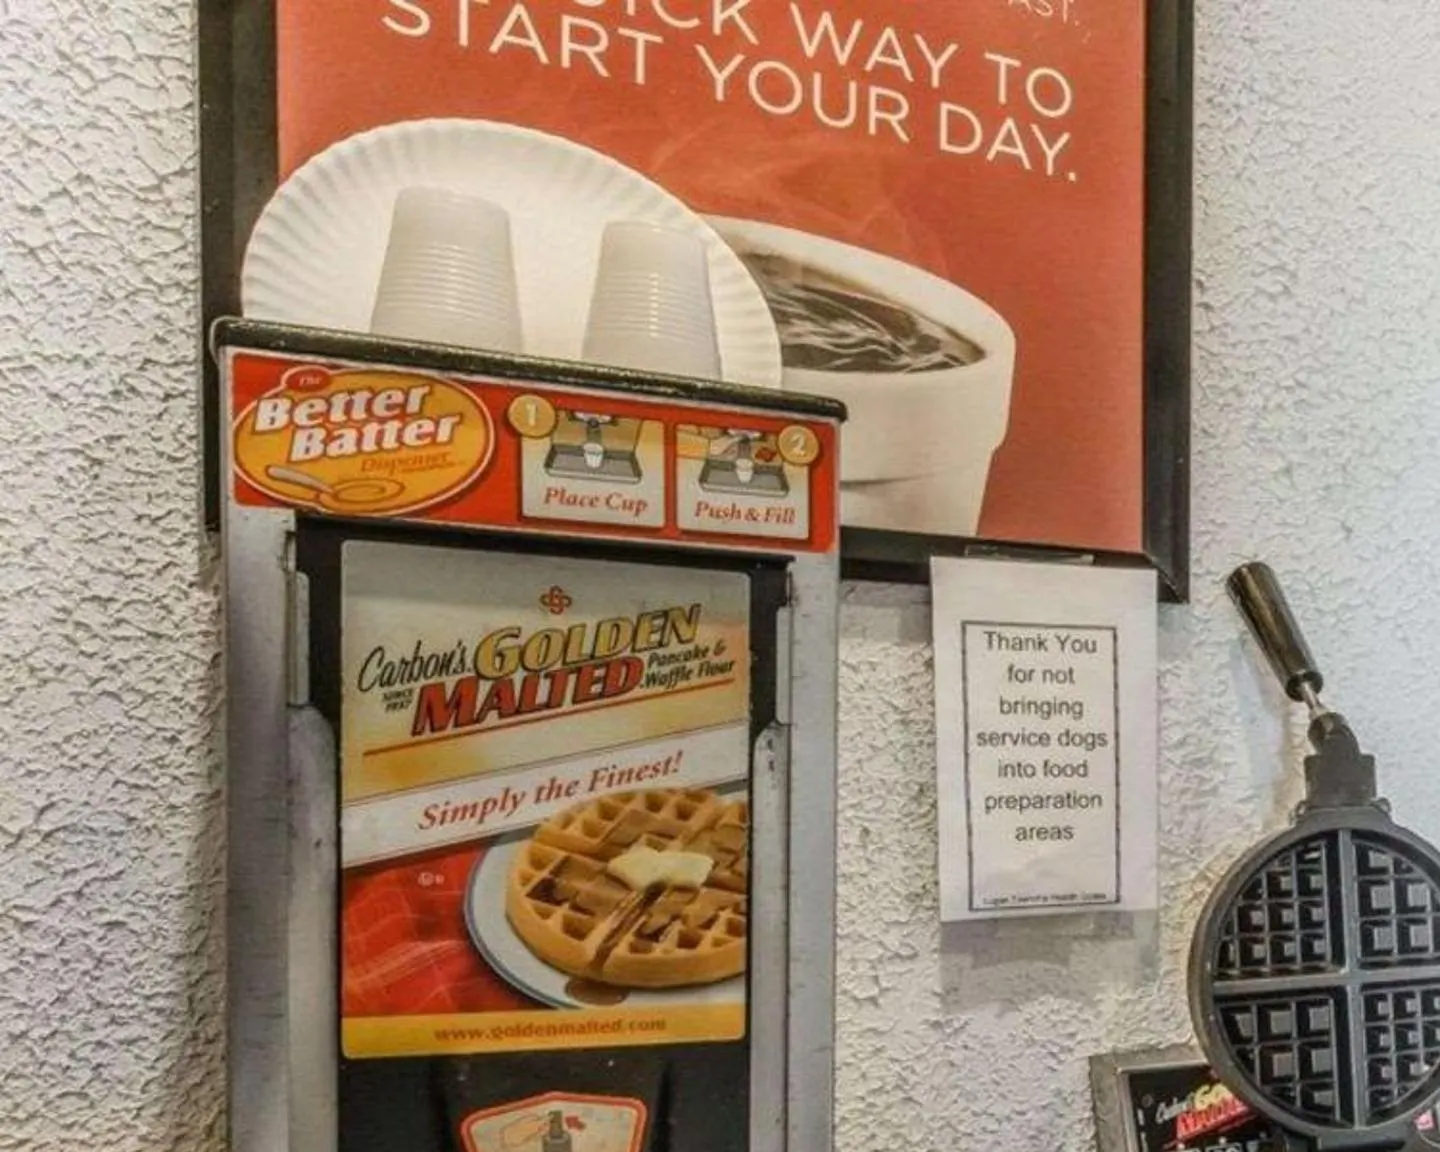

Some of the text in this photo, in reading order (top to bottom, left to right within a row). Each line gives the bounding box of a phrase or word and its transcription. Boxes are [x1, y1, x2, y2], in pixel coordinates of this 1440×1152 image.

[790, 2, 958, 88] WAY
[984, 52, 1072, 118] TO
[381, 0, 1076, 182] START YOUR DAY.
[254, 384, 431, 433] Better
[525, 403, 538, 426] 1
[289, 414, 461, 462] Batter
[544, 486, 648, 517] Place Cup
[695, 501, 796, 525] Push & Fill
[473, 603, 702, 680] GOLDEN
[983, 630, 1098, 654] Thank You
[649, 644, 709, 669] Pancake
[645, 665, 693, 690] Waffle
[1007, 663, 1076, 685] for not
[411, 656, 646, 738] MALTED
[1000, 696, 1084, 720] bringing
[976, 728, 1109, 751] service dogs
[998, 759, 1089, 779] into food
[418, 750, 684, 832] Simply the Finest!
[984, 790, 1104, 815] preparation
[1015, 824, 1075, 842] areas
